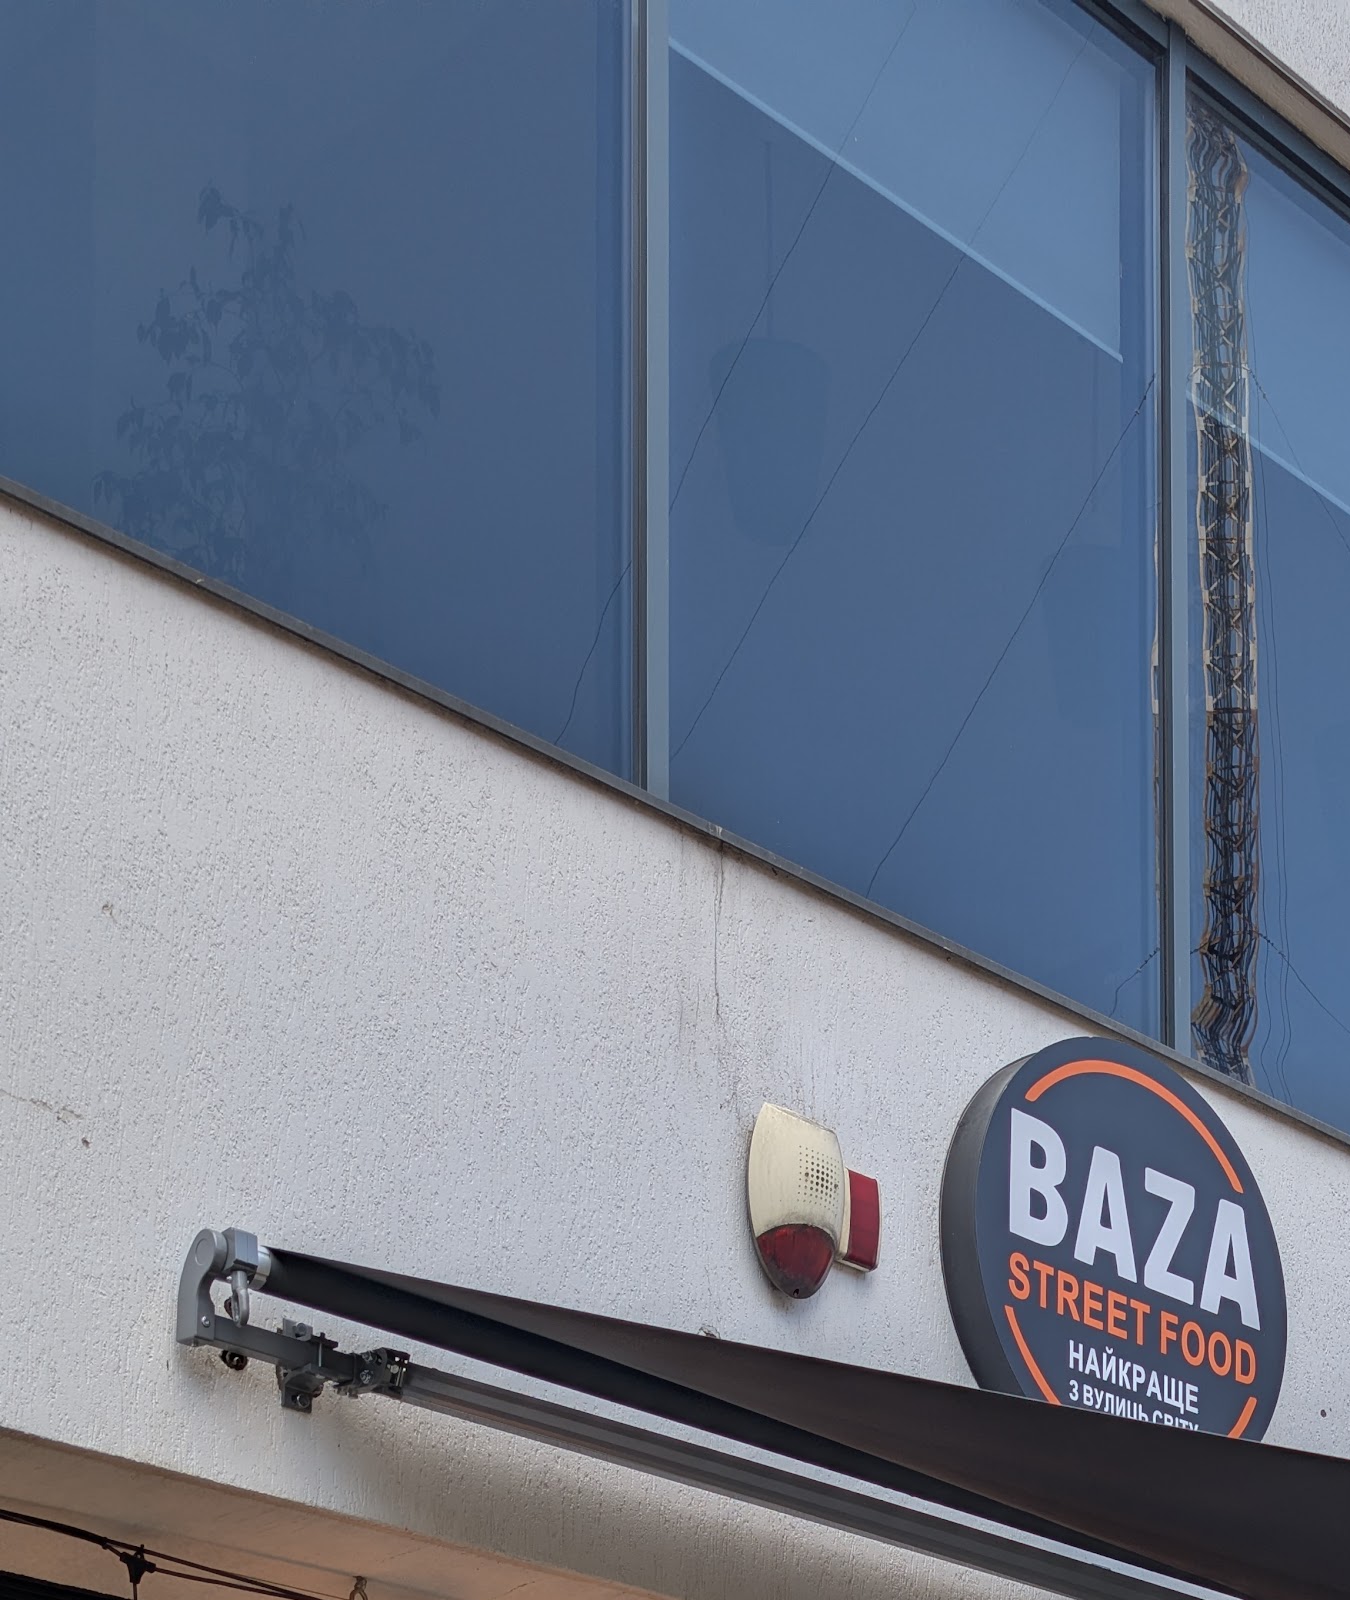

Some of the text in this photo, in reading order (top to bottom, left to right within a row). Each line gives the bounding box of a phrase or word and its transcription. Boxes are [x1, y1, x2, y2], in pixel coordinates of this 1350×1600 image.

[1008, 1107, 1261, 1331] BAZA
[1008, 1251, 1257, 1386] STREET FOOD
[1069, 1339, 1199, 1415] НАЙКРАЩЕ
